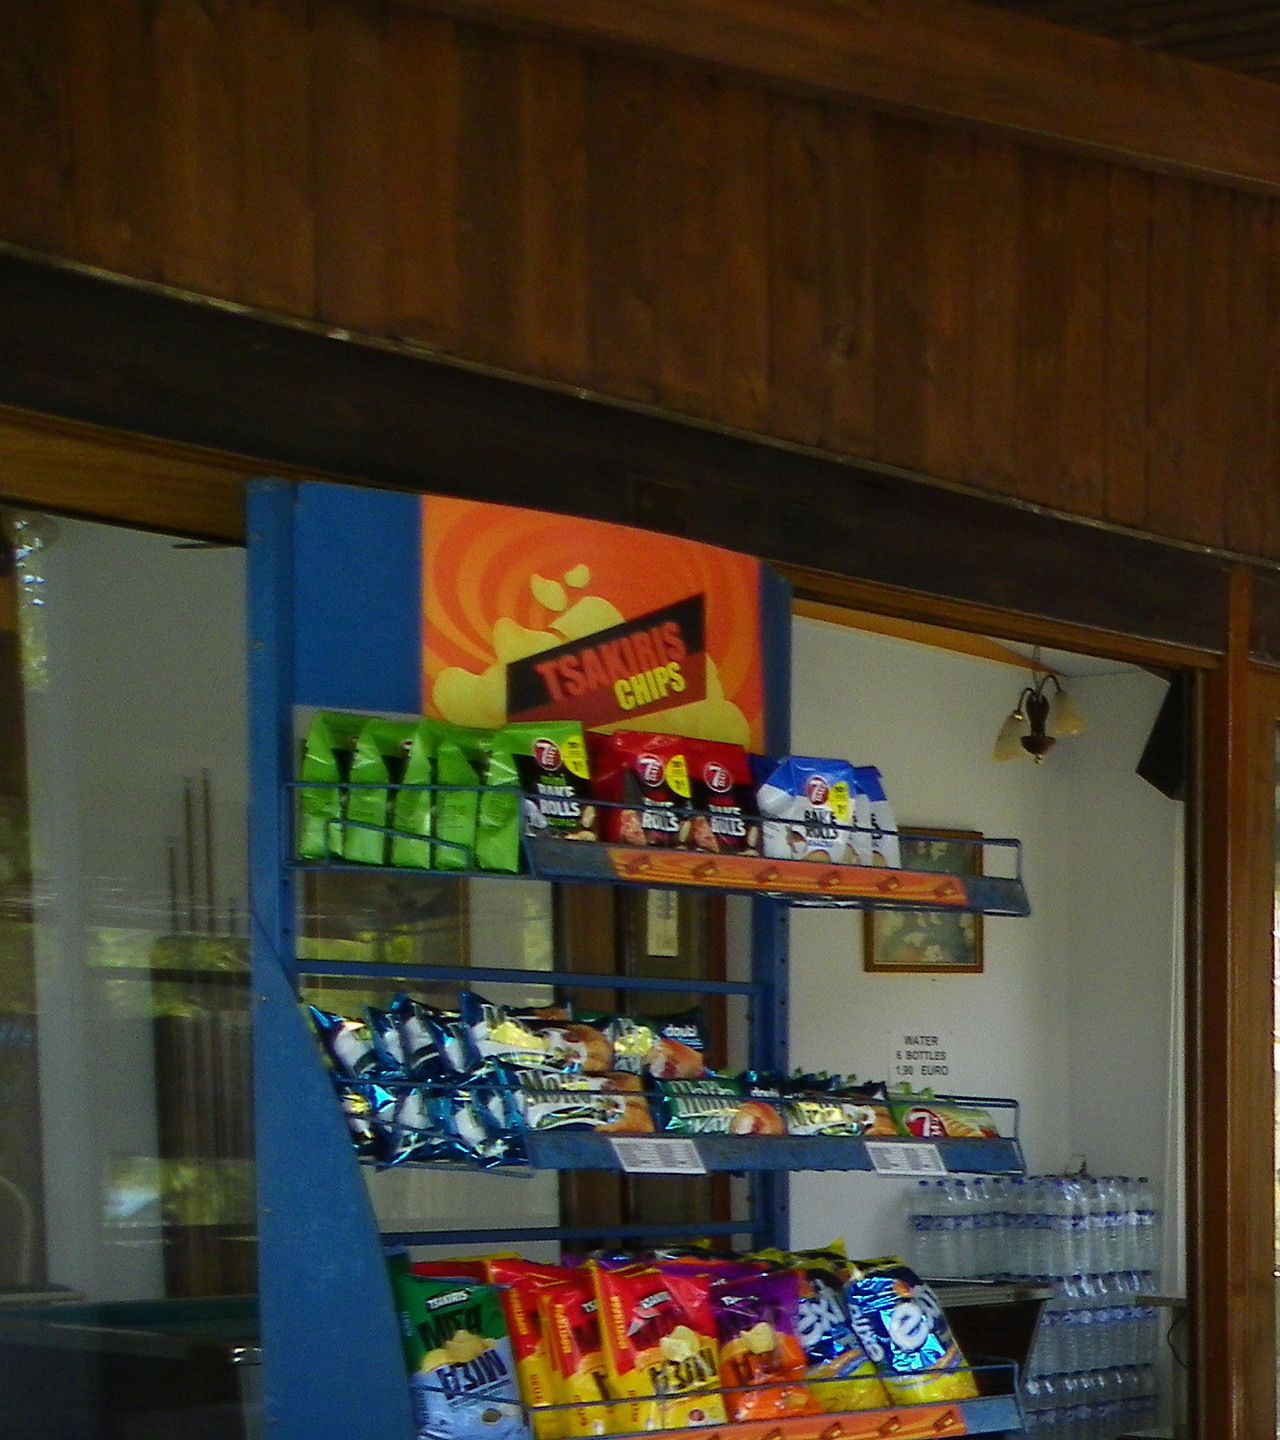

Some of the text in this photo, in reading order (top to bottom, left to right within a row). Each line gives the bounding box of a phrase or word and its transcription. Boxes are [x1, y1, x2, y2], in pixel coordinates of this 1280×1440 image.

[534, 622, 687, 702] TSAKIRIS
[614, 661, 687, 710] CHIPS
[904, 1035, 938, 1046] WATER
[905, 1050, 946, 1061] BOTTLES
[920, 1065, 949, 1076] EURO
